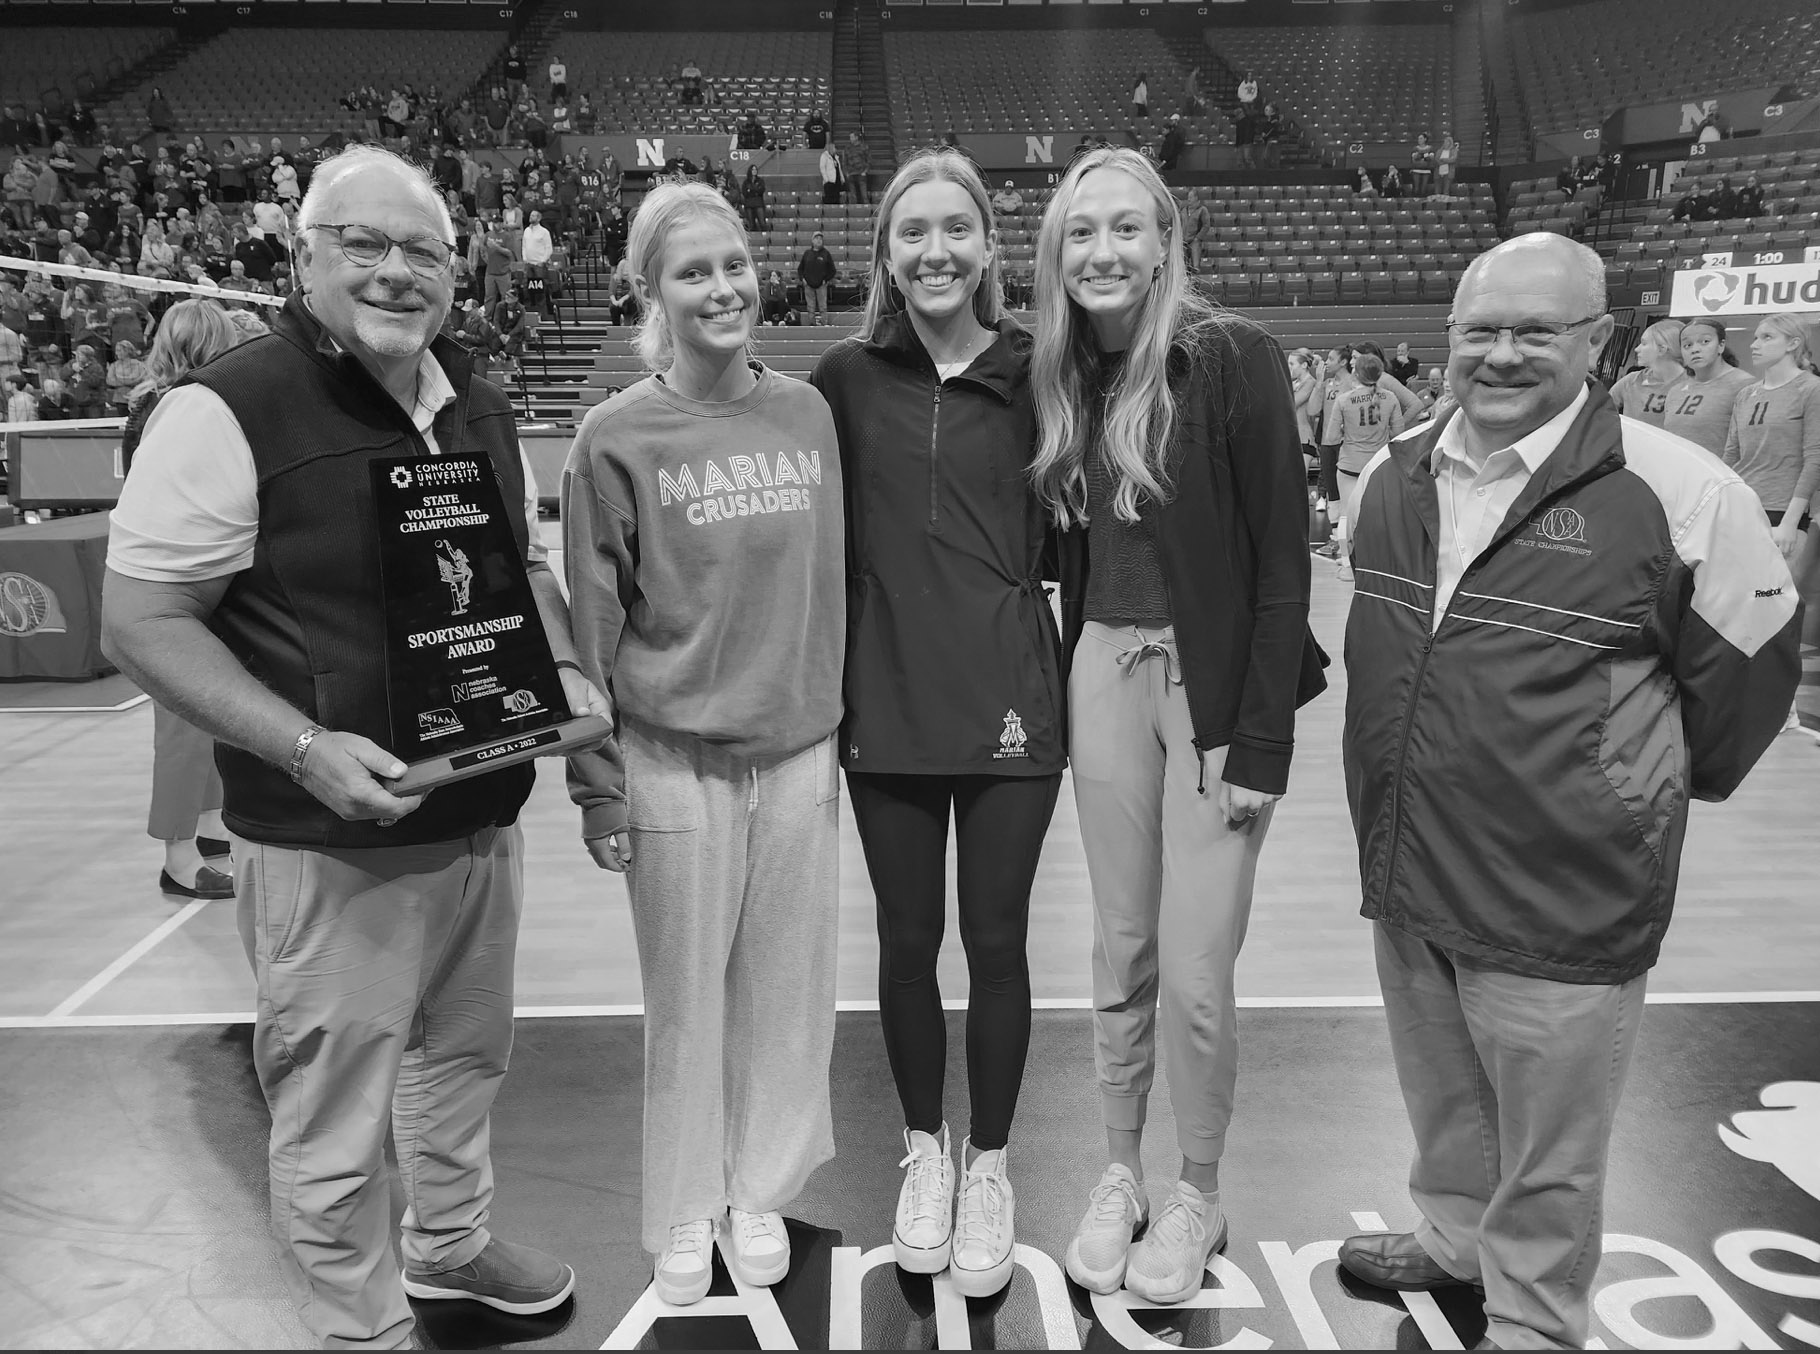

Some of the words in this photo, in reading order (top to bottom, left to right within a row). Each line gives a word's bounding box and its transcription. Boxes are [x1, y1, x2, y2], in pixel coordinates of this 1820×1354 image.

[236, 6, 251, 15] C17
[499, 9, 513, 18] C17
[881, 11, 891, 19] C1
[1140, 8, 1149, 16] C1
[1197, 7, 1208, 15] C2
[1679, 100, 1717, 133] N
[1764, 105, 1783, 117] C3
[1583, 128, 1599, 140] C3
[635, 138, 666, 166] N
[1025, 135, 1054, 163] N
[1349, 143, 1364, 154] C2
[1690, 144, 1706, 156] B3
[730, 151, 750, 161] C18
[581, 175, 600, 186] B16
[1711, 256, 1727, 267] 24
[1753, 251, 1784, 265] 1:00
[528, 279, 544, 290] A14
[1642, 292, 1659, 305] EXIT
[1643, 392, 1667, 414] 13
[1675, 394, 1704, 416] 12
[1748, 401, 1769, 426] 11
[415, 461, 478, 473] CONCORDIA
[416, 468, 479, 482] UNIVERSITY
[658, 450, 822, 507] MARIAN
[422, 494, 460, 507] STATE
[686, 488, 811, 526] CRUSADERS
[405, 503, 481, 521] VOLLEYBALL
[400, 513, 490, 533] CHAMPIONSHIP
[407, 615, 524, 649] SPORTSMANSHIP
[447, 638, 496, 659] AWARD
[468, 676, 498, 687] nebraska
[469, 682, 496, 693] coaches
[470, 686, 507, 699] association
[420, 713, 458, 725] NSIAAA
[476, 745, 507, 760] CLASS
[507, 743, 515, 752] A
[519, 738, 537, 749] 2022
